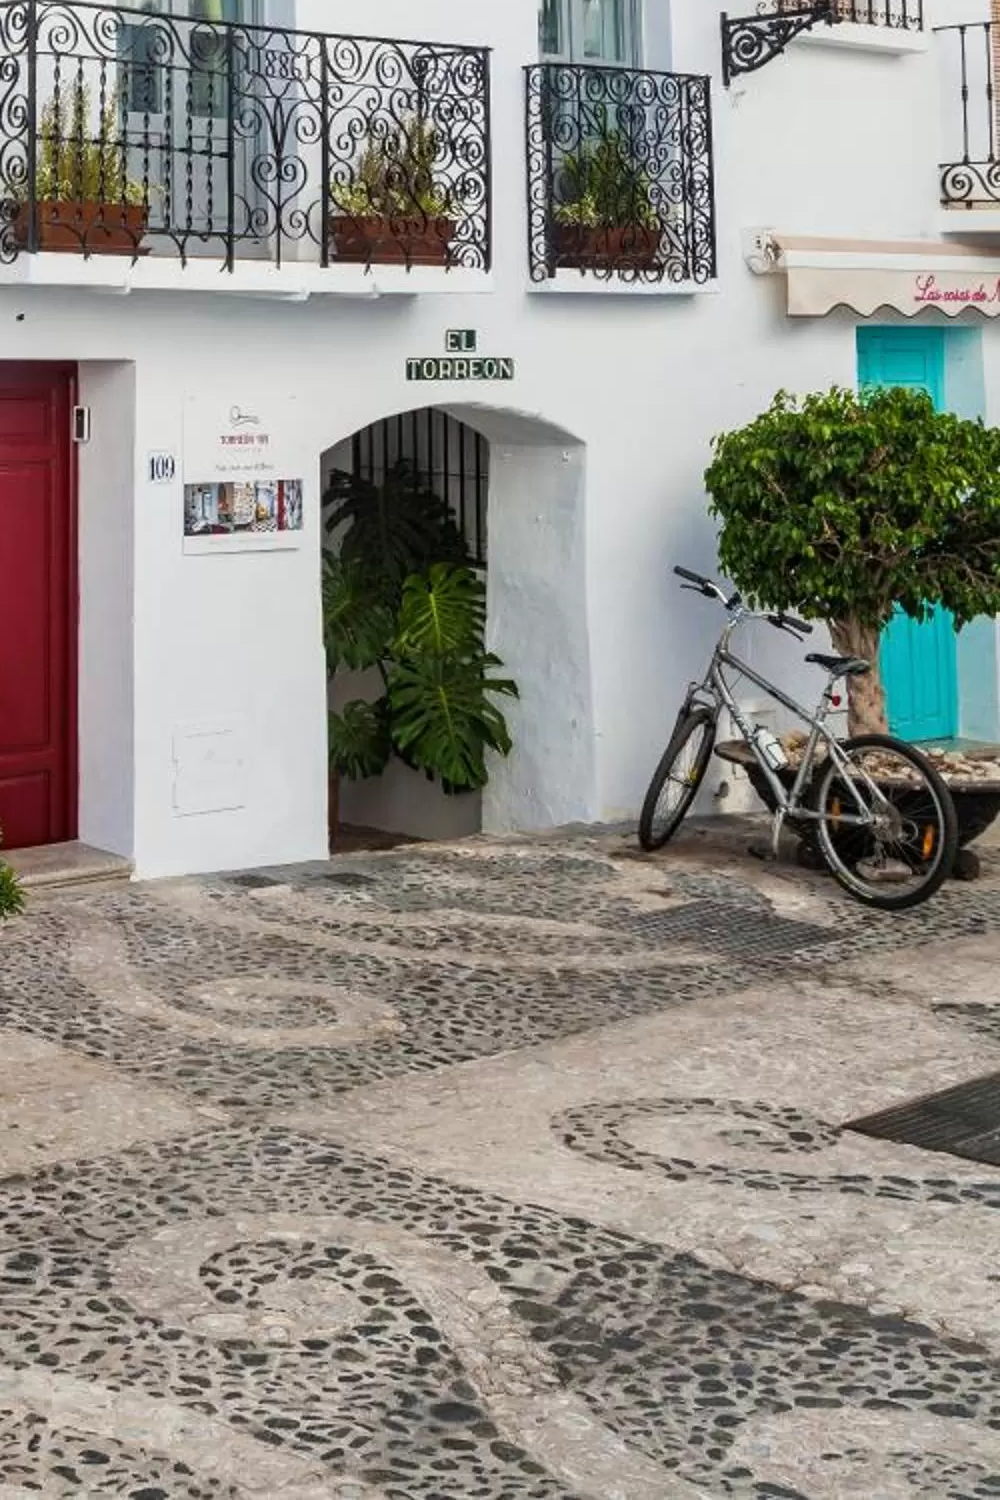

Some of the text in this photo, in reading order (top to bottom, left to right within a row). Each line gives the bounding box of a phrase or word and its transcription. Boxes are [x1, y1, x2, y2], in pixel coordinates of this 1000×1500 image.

[914, 275, 941, 302] Las
[972, 283, 987, 302] de
[447, 331, 476, 352] EL
[407, 359, 513, 380] TORREON
[150, 455, 175, 481] 109
